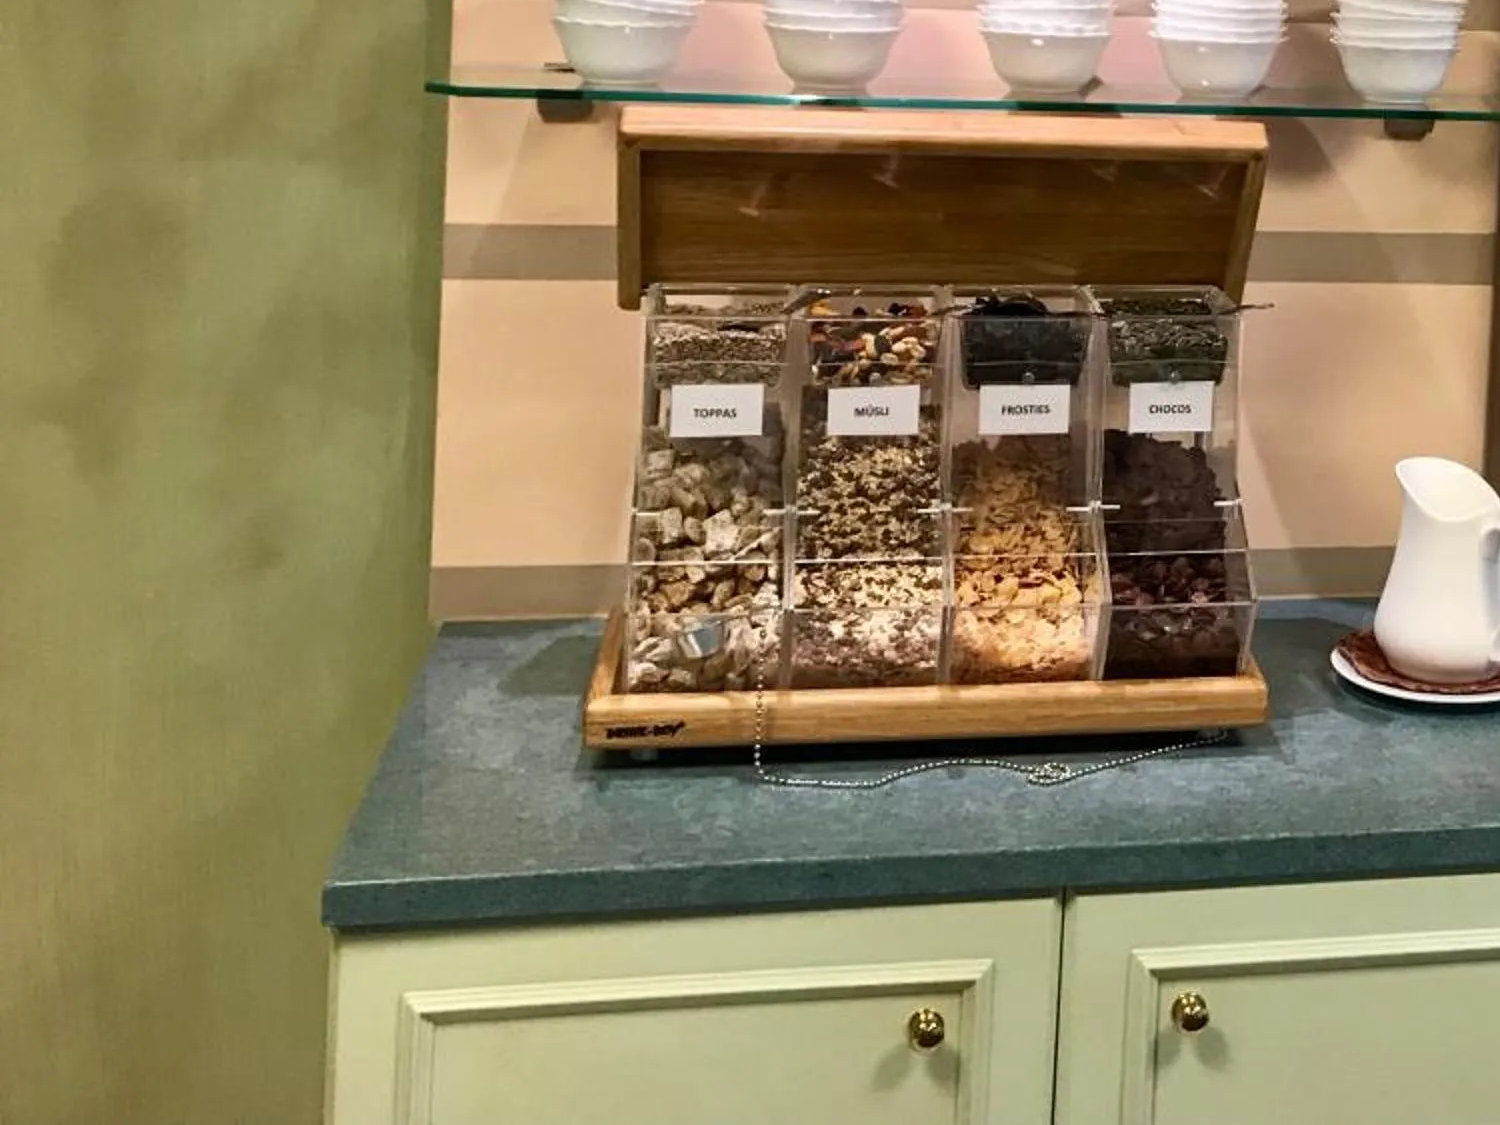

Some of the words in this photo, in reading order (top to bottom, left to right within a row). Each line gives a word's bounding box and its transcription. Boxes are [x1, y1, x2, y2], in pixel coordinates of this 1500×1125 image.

[693, 407, 737, 419] TOPPAS
[853, 403, 890, 417] MÜSLI
[1001, 404, 1051, 416] FROSTIES
[1149, 403, 1192, 414] CHOCOS
